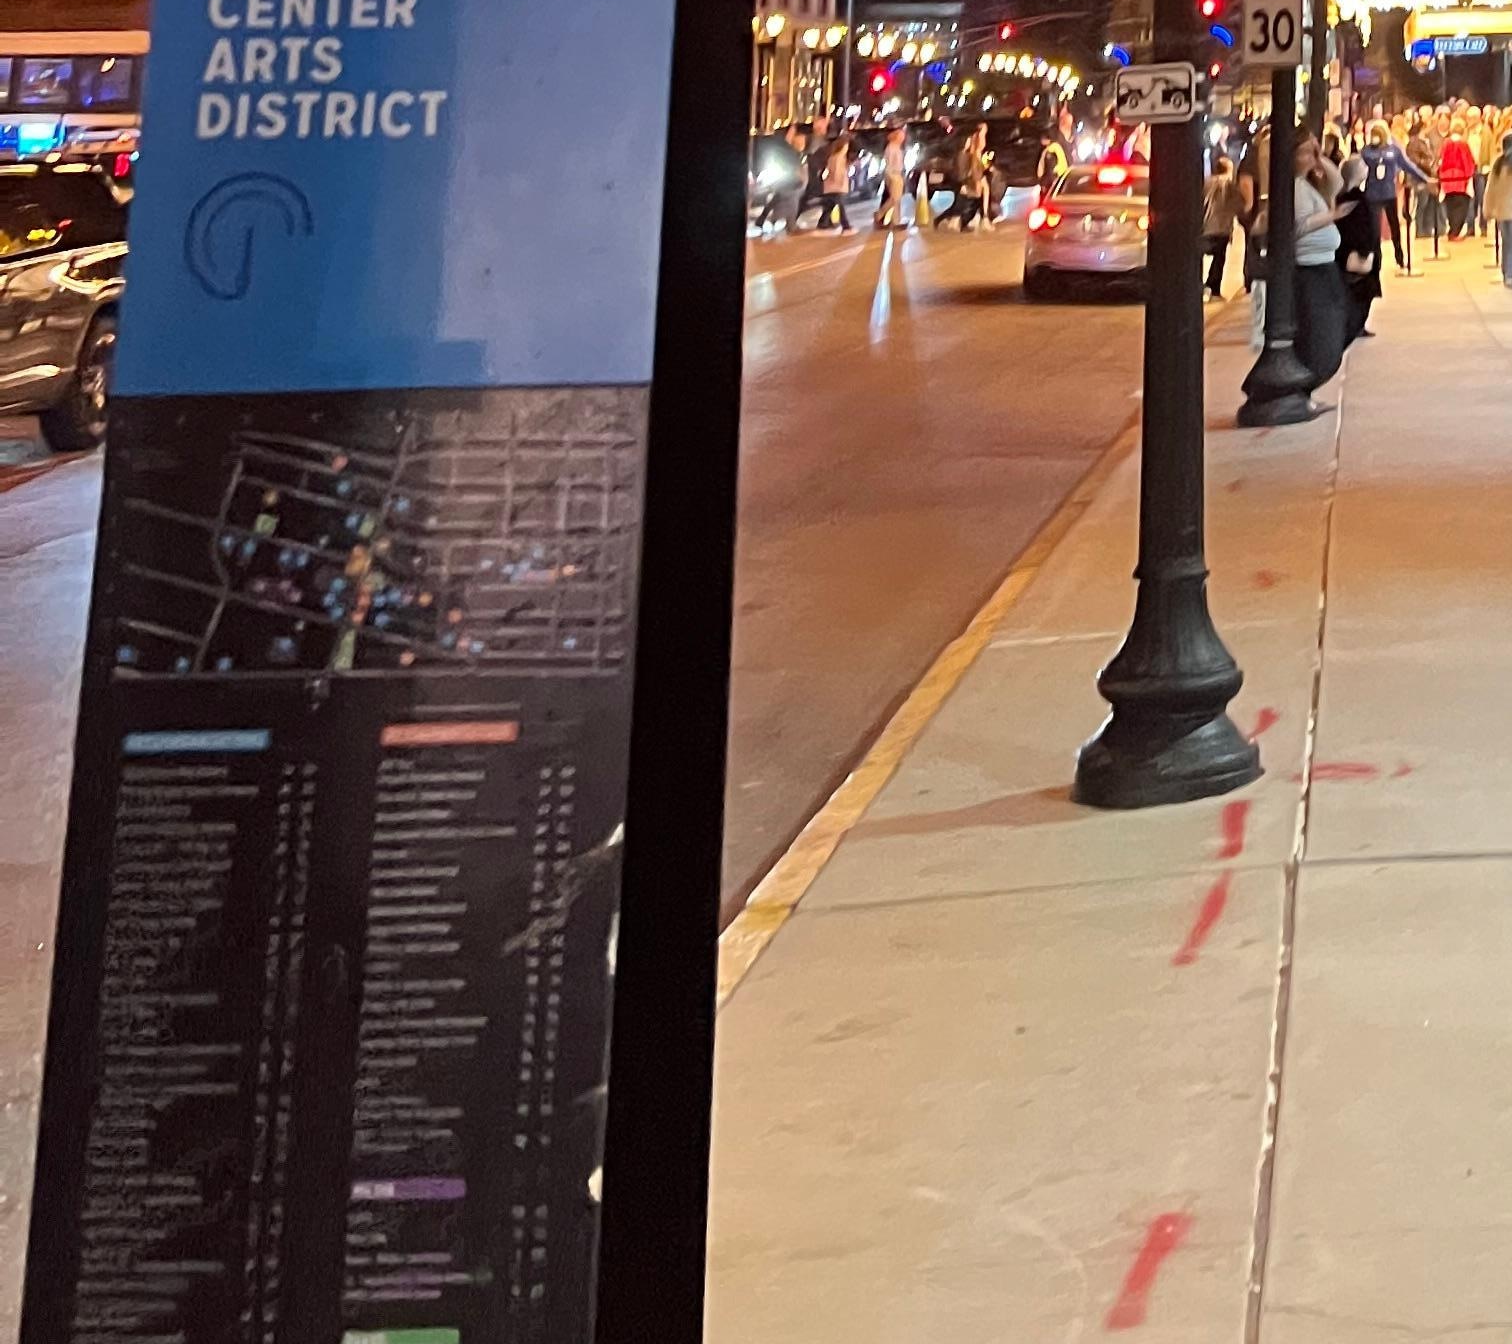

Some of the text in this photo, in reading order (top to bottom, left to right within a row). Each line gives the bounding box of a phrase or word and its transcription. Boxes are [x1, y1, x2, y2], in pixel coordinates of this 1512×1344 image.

[1250, 8, 1295, 53] 30
[203, 37, 343, 84] ARTS
[197, 90, 448, 139] DISTRICT
